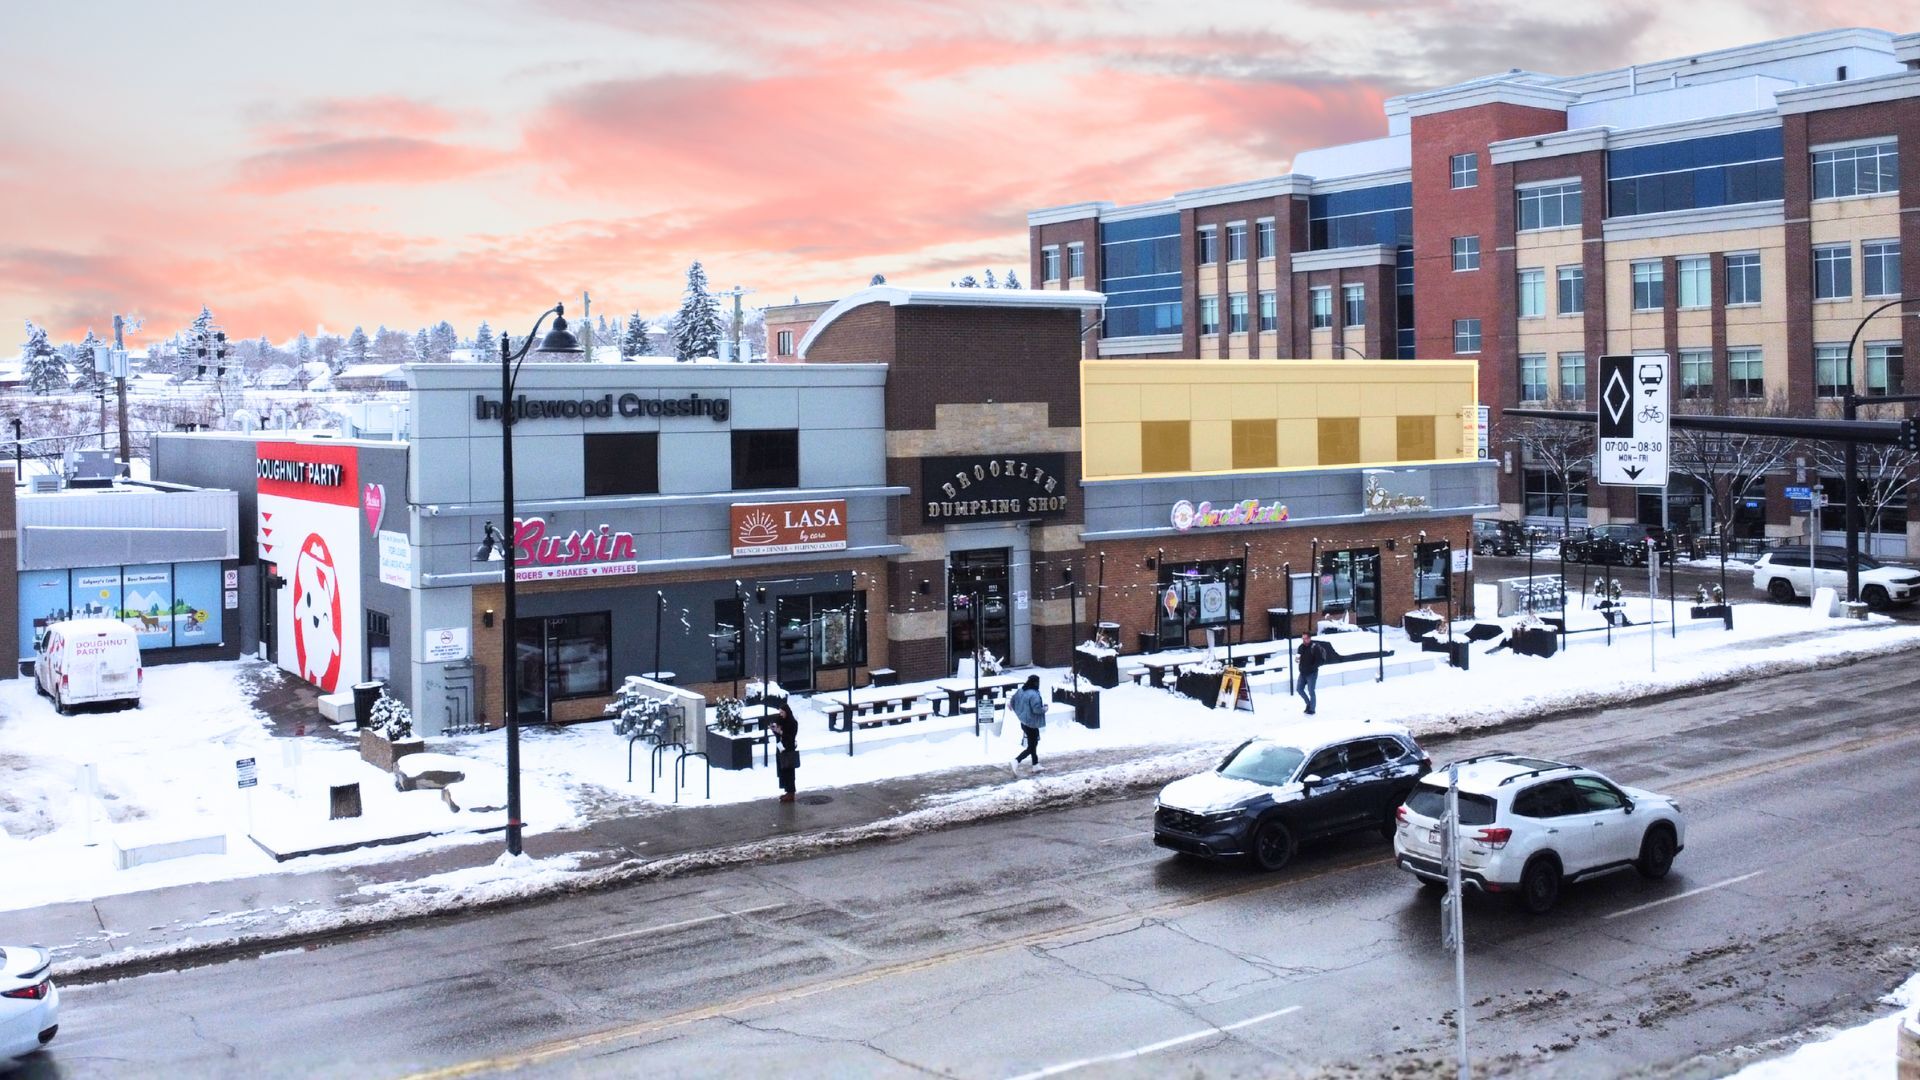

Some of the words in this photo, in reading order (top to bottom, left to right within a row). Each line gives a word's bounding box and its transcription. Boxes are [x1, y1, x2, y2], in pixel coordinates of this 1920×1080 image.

[618, 393, 730, 421] Crossing
[256, 457, 305, 483] DOUGHNUT
[308, 462, 341, 487] PARTY
[942, 460, 1058, 499] BROOKLYN
[928, 499, 1020, 518] DUMPLING
[1027, 495, 1068, 513] SHOP
[783, 508, 842, 529] LASA
[514, 516, 637, 566] Bussin
[799, 530, 809, 542] by
[766, 546, 789, 554] DINNER
[556, 567, 588, 577] SHAKES
[601, 564, 637, 574] WAFFLES
[76, 638, 128, 649] DOUGHNUT
[76, 648, 106, 656] PARTY
